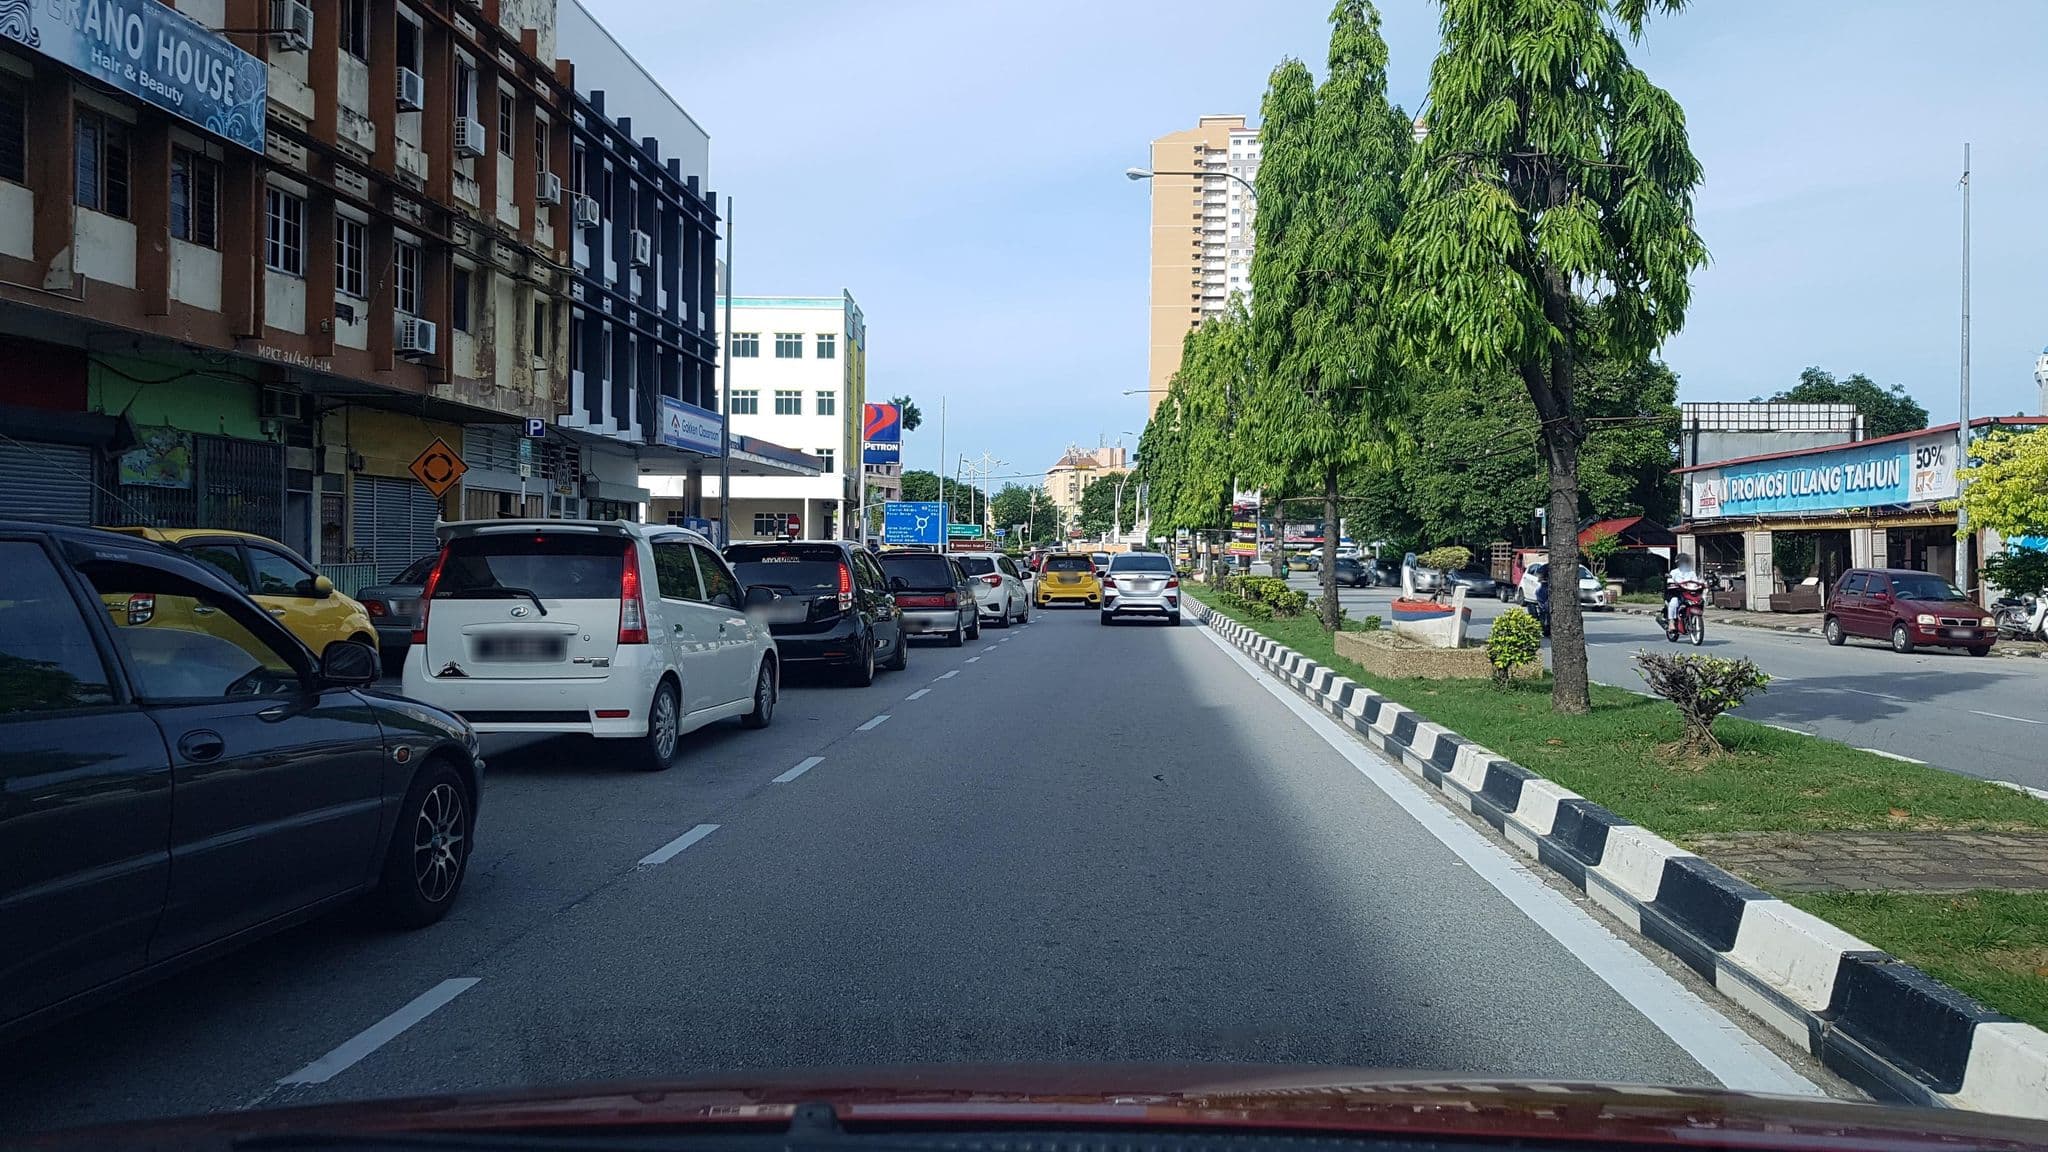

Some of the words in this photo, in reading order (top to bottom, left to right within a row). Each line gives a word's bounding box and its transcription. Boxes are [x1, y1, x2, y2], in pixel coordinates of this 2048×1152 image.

[92, 46, 121, 75] Hair
[124, 65, 137, 82] &
[139, 74, 184, 106] Beauty
[157, 29, 235, 107] HOUSE
[530, 419, 542, 436] P
[864, 442, 899, 451] PETRON
[1916, 446, 1945, 470] 50%
[1731, 472, 1787, 502] PROMOSI
[1791, 466, 1841, 497] ULANG
[1844, 457, 1900, 492] TAHUN
